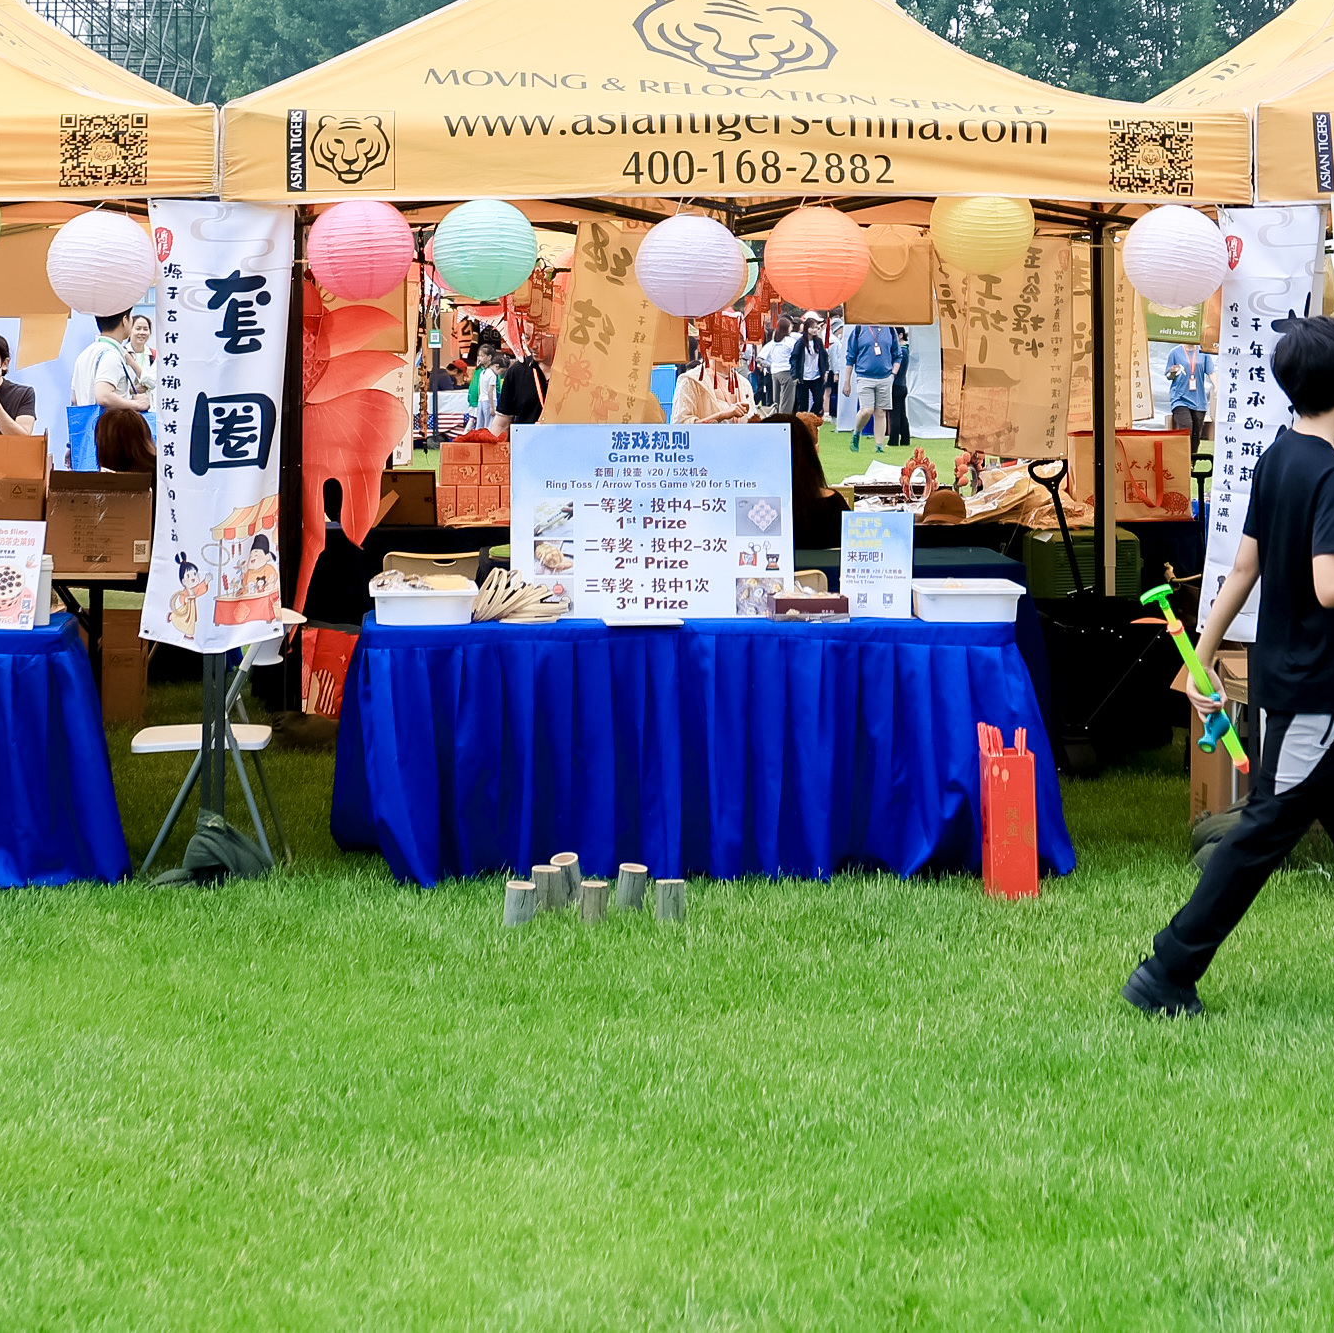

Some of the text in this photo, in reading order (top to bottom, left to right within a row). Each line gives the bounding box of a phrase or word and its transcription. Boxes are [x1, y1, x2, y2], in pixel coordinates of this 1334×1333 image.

[424, 68, 1055, 116] MOVING & RELOCATION SERVICES
[444, 111, 1048, 145] www.asiantigers-china.com
[289, 111, 303, 190] ASIAN TIGERS
[1315, 113, 1334, 191] ASIAN TIGERS
[622, 149, 895, 185] 400-168-2882
[189, 269, 276, 477] 套圈
[611, 431, 690, 450] 游戏规则
[608, 452, 694, 463] Game Rules
[594, 468, 614, 477] 套圈
[622, 468, 642, 477] 投壶
[673, 468, 709, 477] 5次机会
[545, 481, 568, 491] Ring
[570, 481, 592, 489] Toss
[602, 481, 632, 489] Arrow
[635, 480, 657, 489] Toss
[659, 480, 688, 488] Game
[709, 480, 723, 488] for
[725, 480, 731, 488] 5
[733, 480, 757, 488] Tries
[616, 516, 687, 529] 1st Prize
[848, 528, 878, 538] PLAY
[615, 556, 689, 569] 2nd Prize
[616, 596, 689, 610] 3rd Prize
